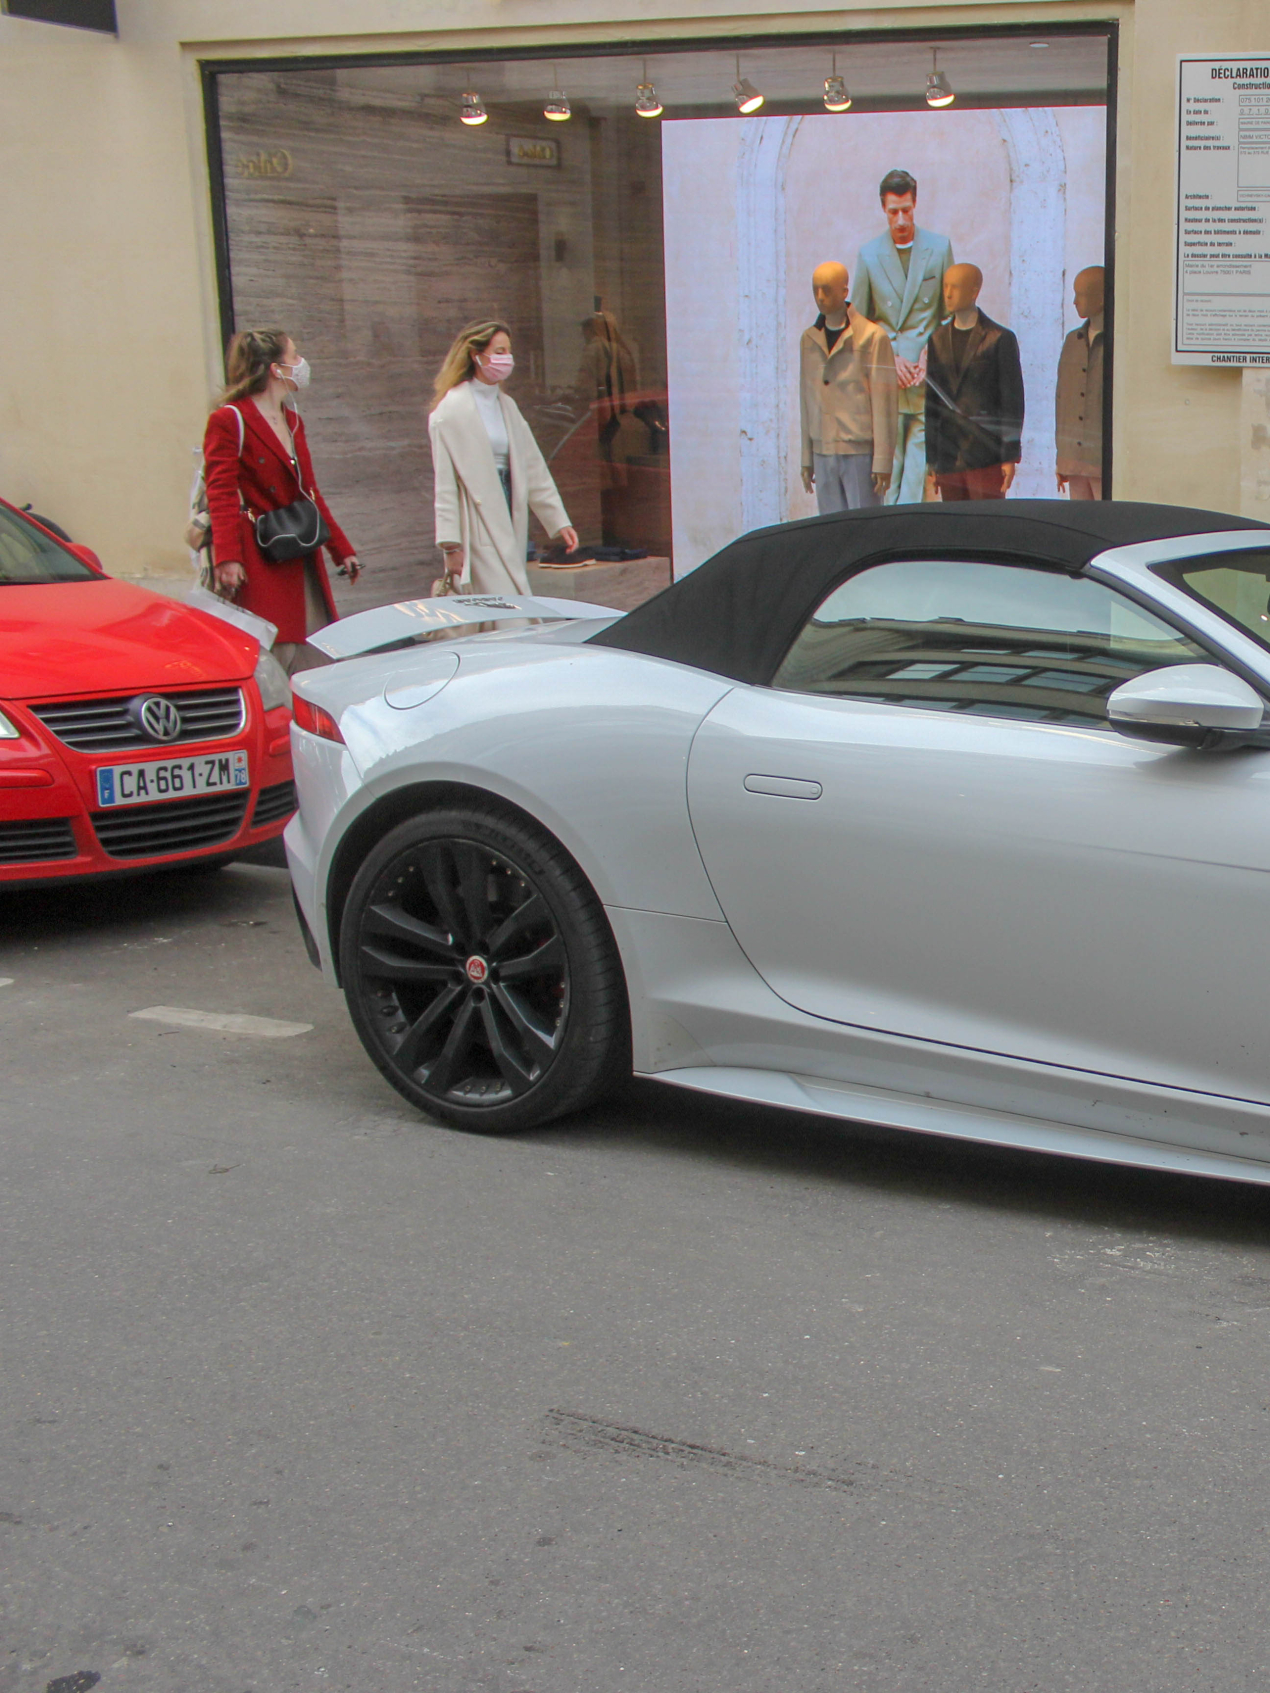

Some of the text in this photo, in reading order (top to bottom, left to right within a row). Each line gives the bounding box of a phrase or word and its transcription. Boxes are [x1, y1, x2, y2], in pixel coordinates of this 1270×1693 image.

[1211, 354, 1247, 363] CHANTIER
[119, 757, 231, 799] CA-661-ZM
[234, 770, 246, 785] 78
[104, 789, 110, 799] F
